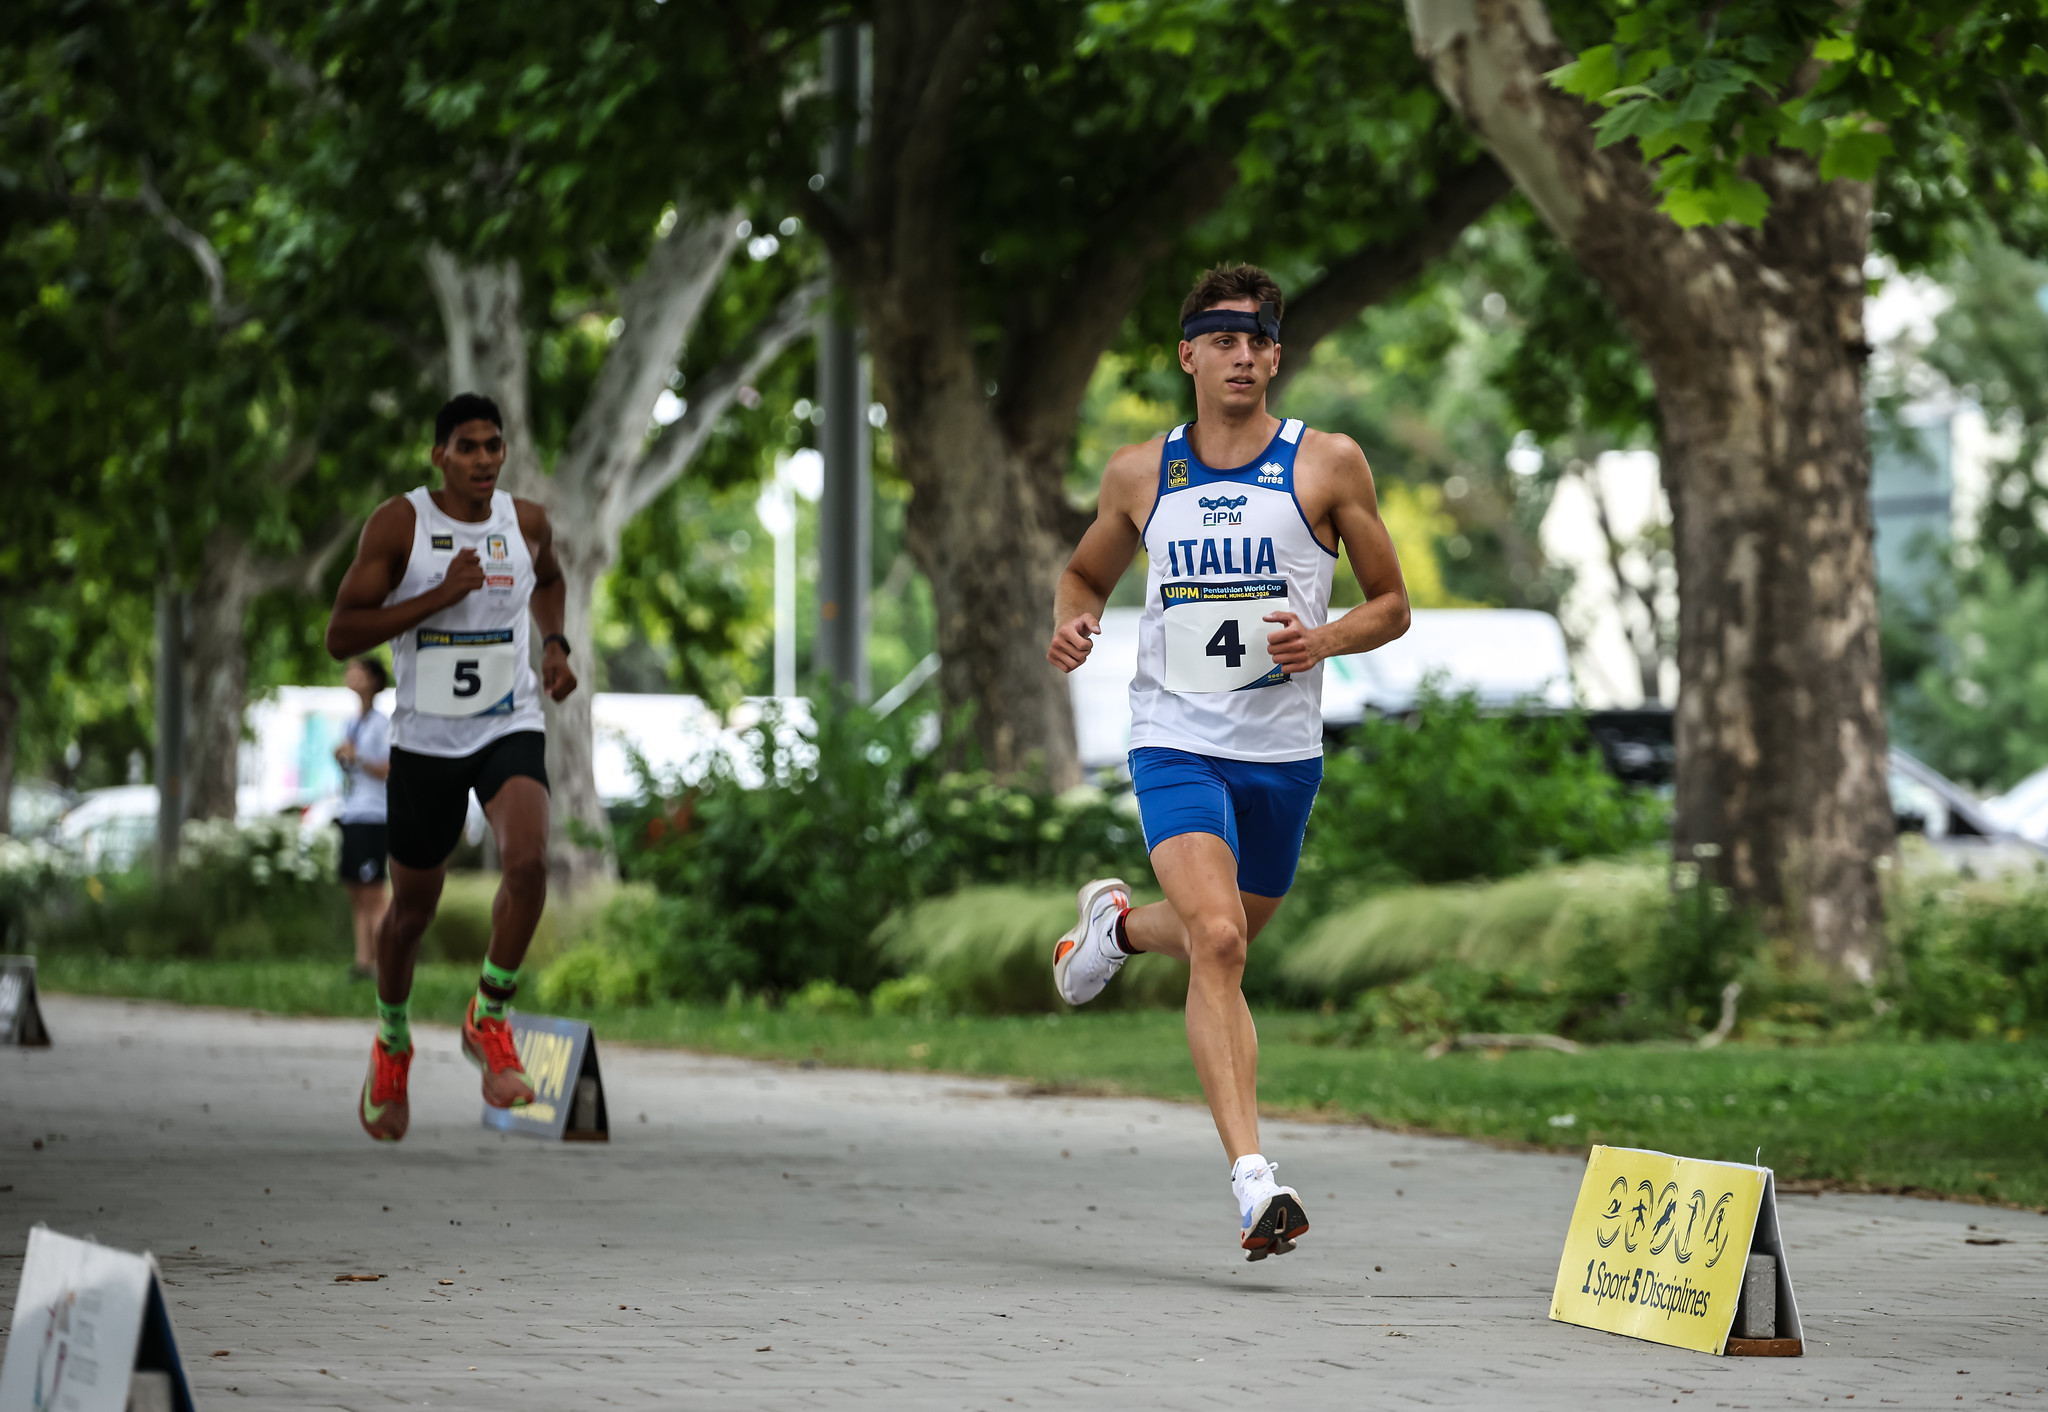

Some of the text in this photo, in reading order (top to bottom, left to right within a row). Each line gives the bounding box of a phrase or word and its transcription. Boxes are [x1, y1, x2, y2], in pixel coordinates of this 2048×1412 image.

[1170, 477, 1187, 485] UIPM
[1257, 475, 1284, 485] errea
[1203, 511, 1242, 525] FIPM
[1168, 537, 1278, 577] ITALIA
[1165, 587, 1200, 599] UIPM
[1203, 583, 1281, 594] Pentathlon World Cup
[1205, 619, 1246, 668] 4
[453, 660, 481, 697] 5
[1582, 1259, 1711, 1321] 1 Sport 5 Disciplines
